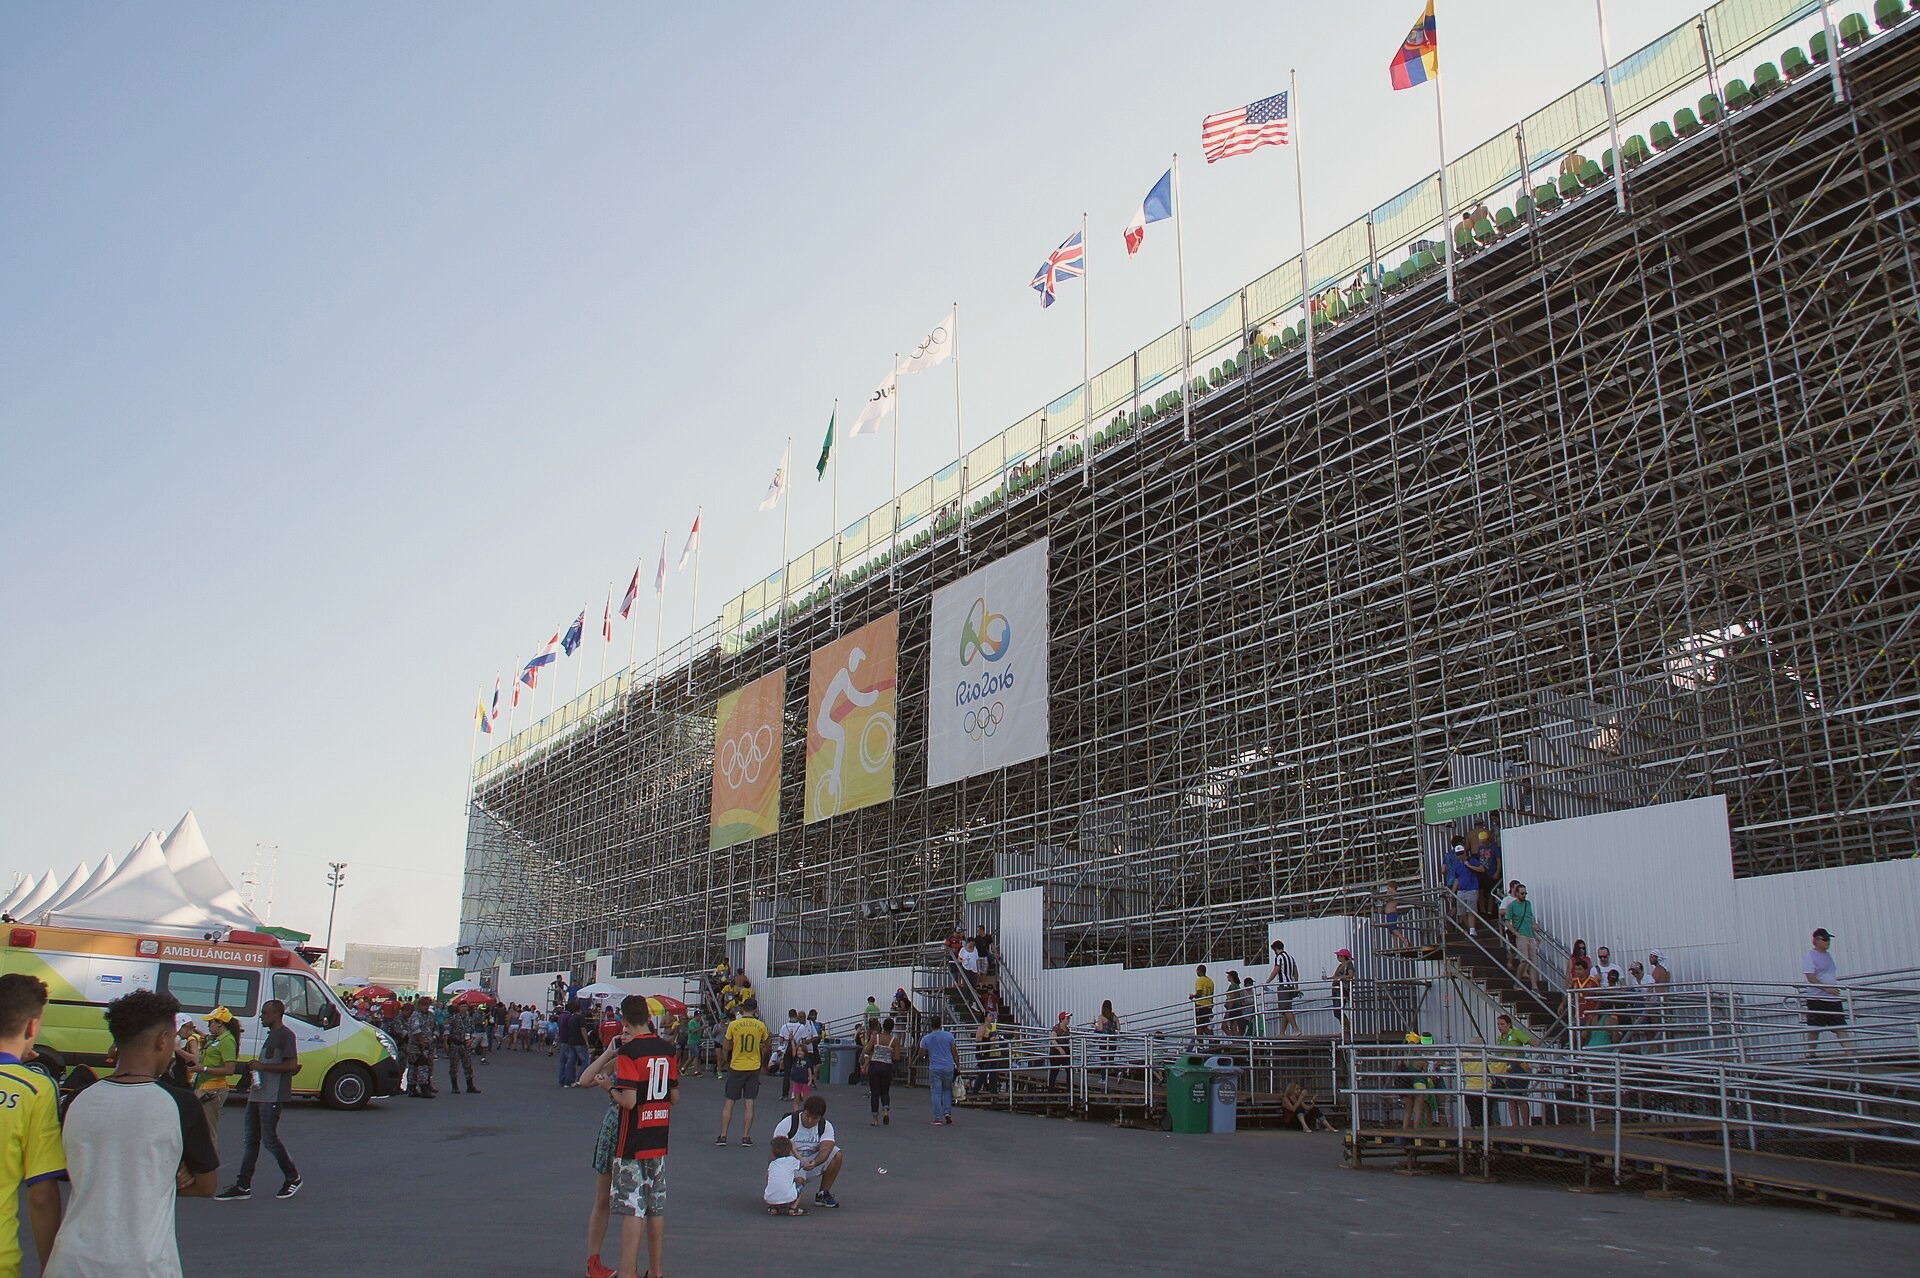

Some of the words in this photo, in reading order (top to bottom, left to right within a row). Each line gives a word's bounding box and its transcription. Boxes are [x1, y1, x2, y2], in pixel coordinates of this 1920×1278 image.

[162, 946, 242, 961] AMBULÂNCIA
[244, 953, 264, 963] 015
[740, 1033, 755, 1053] 10
[647, 1057, 669, 1100] 10
